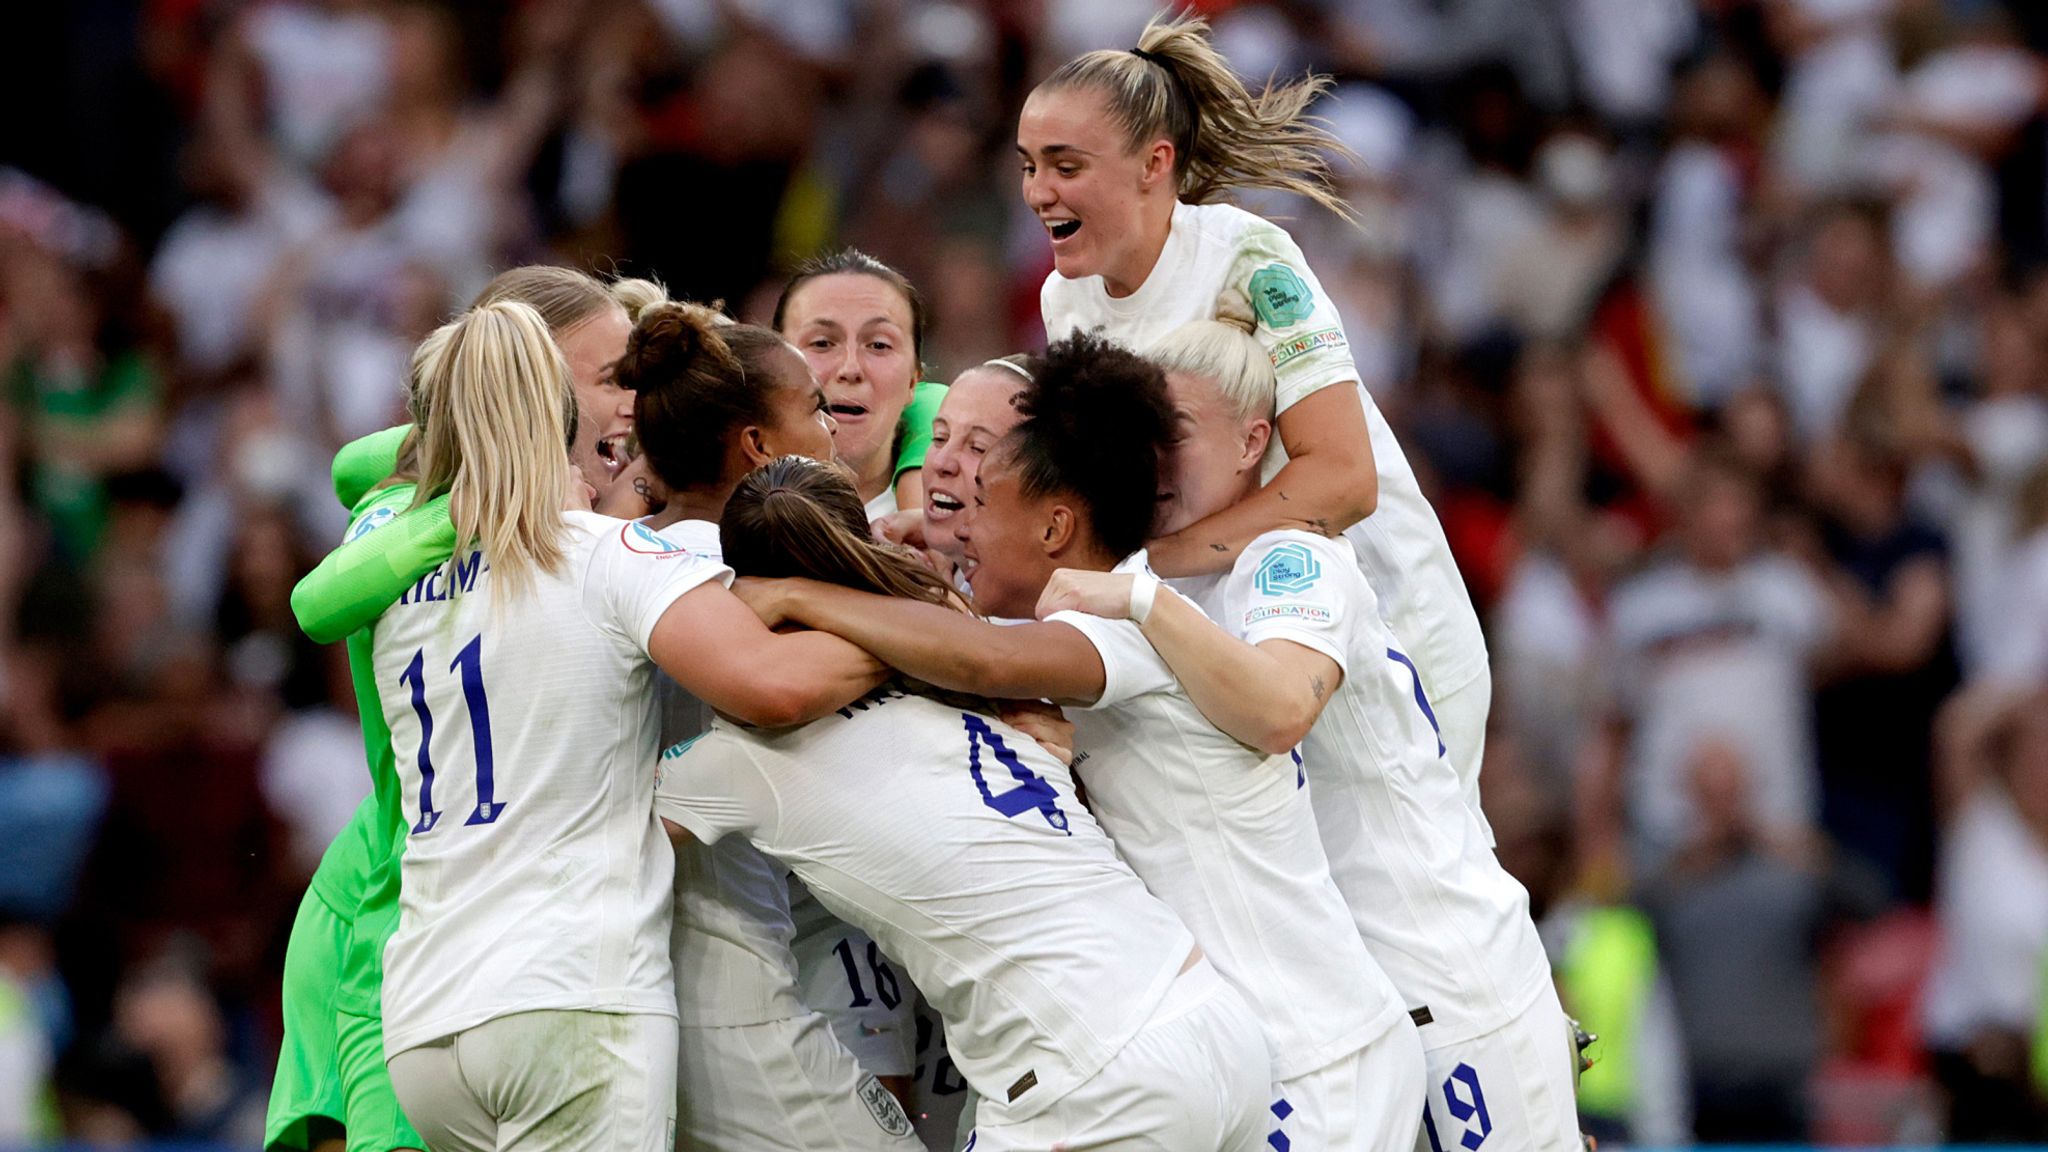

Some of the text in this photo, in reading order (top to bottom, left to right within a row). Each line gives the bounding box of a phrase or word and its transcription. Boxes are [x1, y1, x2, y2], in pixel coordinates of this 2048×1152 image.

[1269, 329, 1344, 367] FOUNDATION
[1244, 606, 1331, 623] FOUNDATION
[398, 632, 507, 836] 11
[961, 712, 1072, 837] 4
[831, 937, 902, 1011] 16
